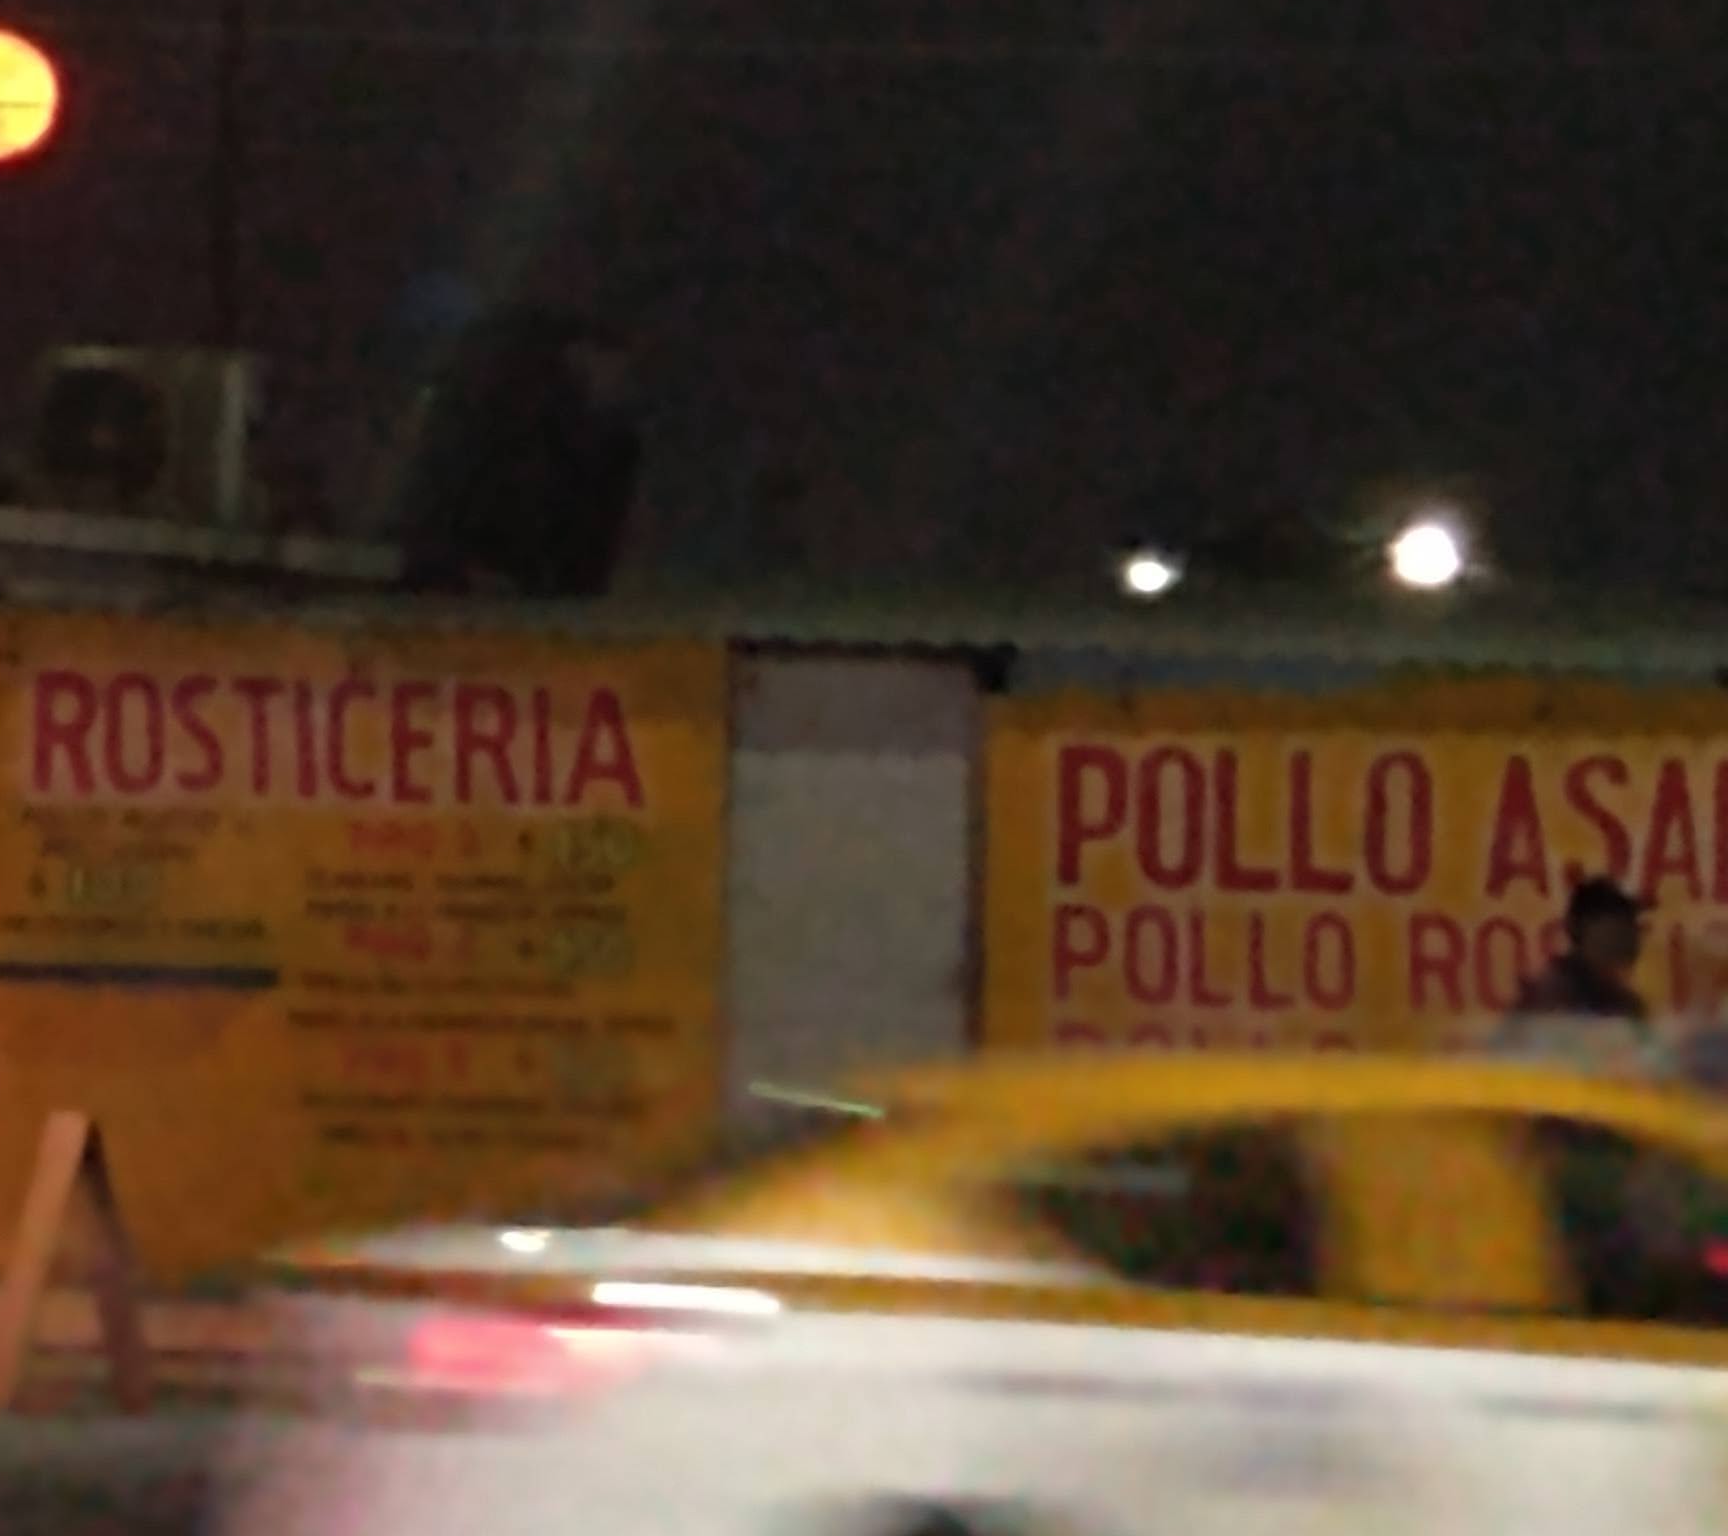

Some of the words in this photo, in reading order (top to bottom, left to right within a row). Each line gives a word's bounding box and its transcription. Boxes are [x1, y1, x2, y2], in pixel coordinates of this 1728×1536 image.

[30, 669, 646, 809] ROSTICERIA
[1056, 744, 1436, 896] POLLO
[1052, 902, 1357, 1012] POLLO
